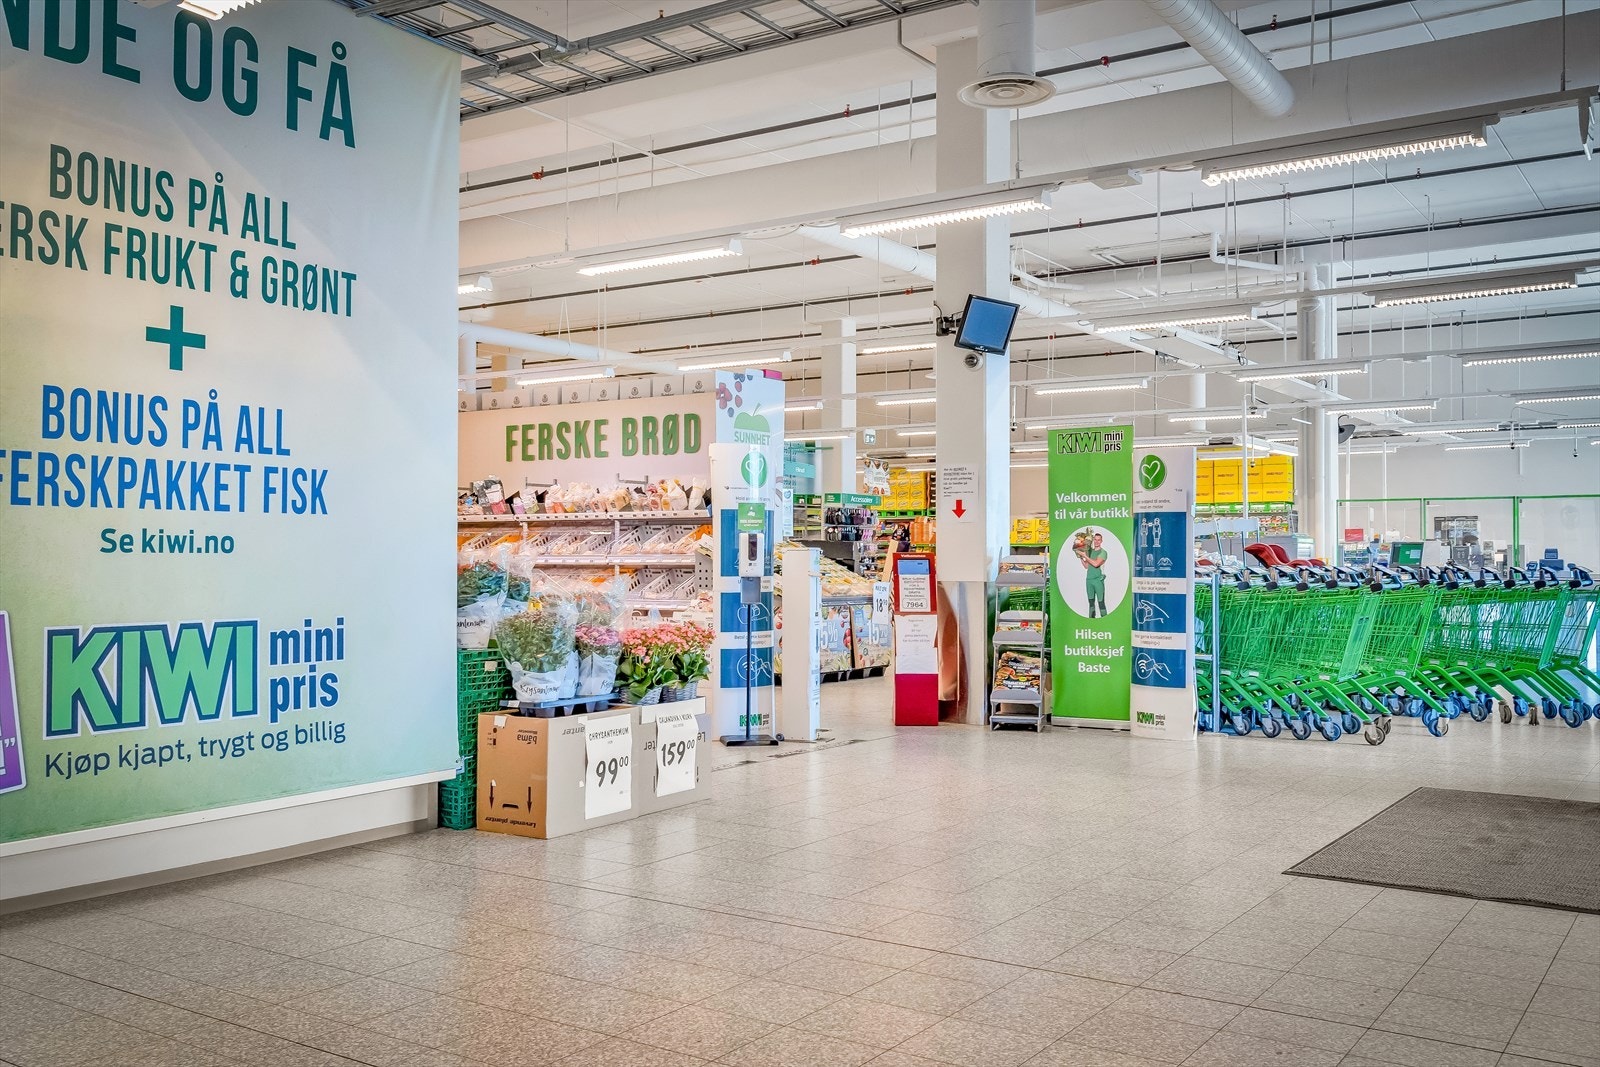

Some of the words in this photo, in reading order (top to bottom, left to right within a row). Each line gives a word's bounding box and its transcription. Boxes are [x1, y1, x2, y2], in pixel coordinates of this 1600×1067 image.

[173, 9, 259, 117] OG
[286, 41, 356, 149] FÅ
[50, 143, 174, 222] BONUS
[189, 171, 229, 235] PÅ
[241, 192, 297, 250] ALL
[104, 222, 218, 293] FRUKT
[230, 249, 249, 300] &
[261, 255, 357, 317] GRØNT
[41, 384, 168, 447] BONUS
[182, 388, 223, 451] PÅ
[235, 405, 291, 457] ALL
[505, 418, 609, 462] FERSKE
[621, 413, 701, 456] BRØD
[734, 431, 771, 446] SUNNHET
[1057, 431, 1102, 454] KIWI
[1104, 430, 1123, 441] mini
[1104, 441, 1121, 453] pris
[263, 466, 328, 515] FISK
[1056, 492, 1126, 503] Velkommen
[1055, 509, 1066, 519] til
[1069, 508, 1087, 519] vår
[1090, 507, 1129, 518] butikk
[100, 528, 134, 554] Se
[141, 529, 235, 554] kiwi.no
[1075, 629, 1112, 640] Hilsen
[1064, 645, 1124, 659] butikksjef
[46, 620, 259, 739] KIWI
[270, 616, 345, 666] mini
[1078, 662, 1110, 673] Baste
[270, 664, 339, 724] pris
[1136, 711, 1154, 727] KIWI
[588, 727, 629, 741] CHRYSANTHEMUM
[45, 752, 111, 780] Kjøp
[118, 739, 191, 771] kjapt,
[198, 733, 255, 758] trygt
[261, 729, 289, 752] og
[295, 722, 346, 745] billig
